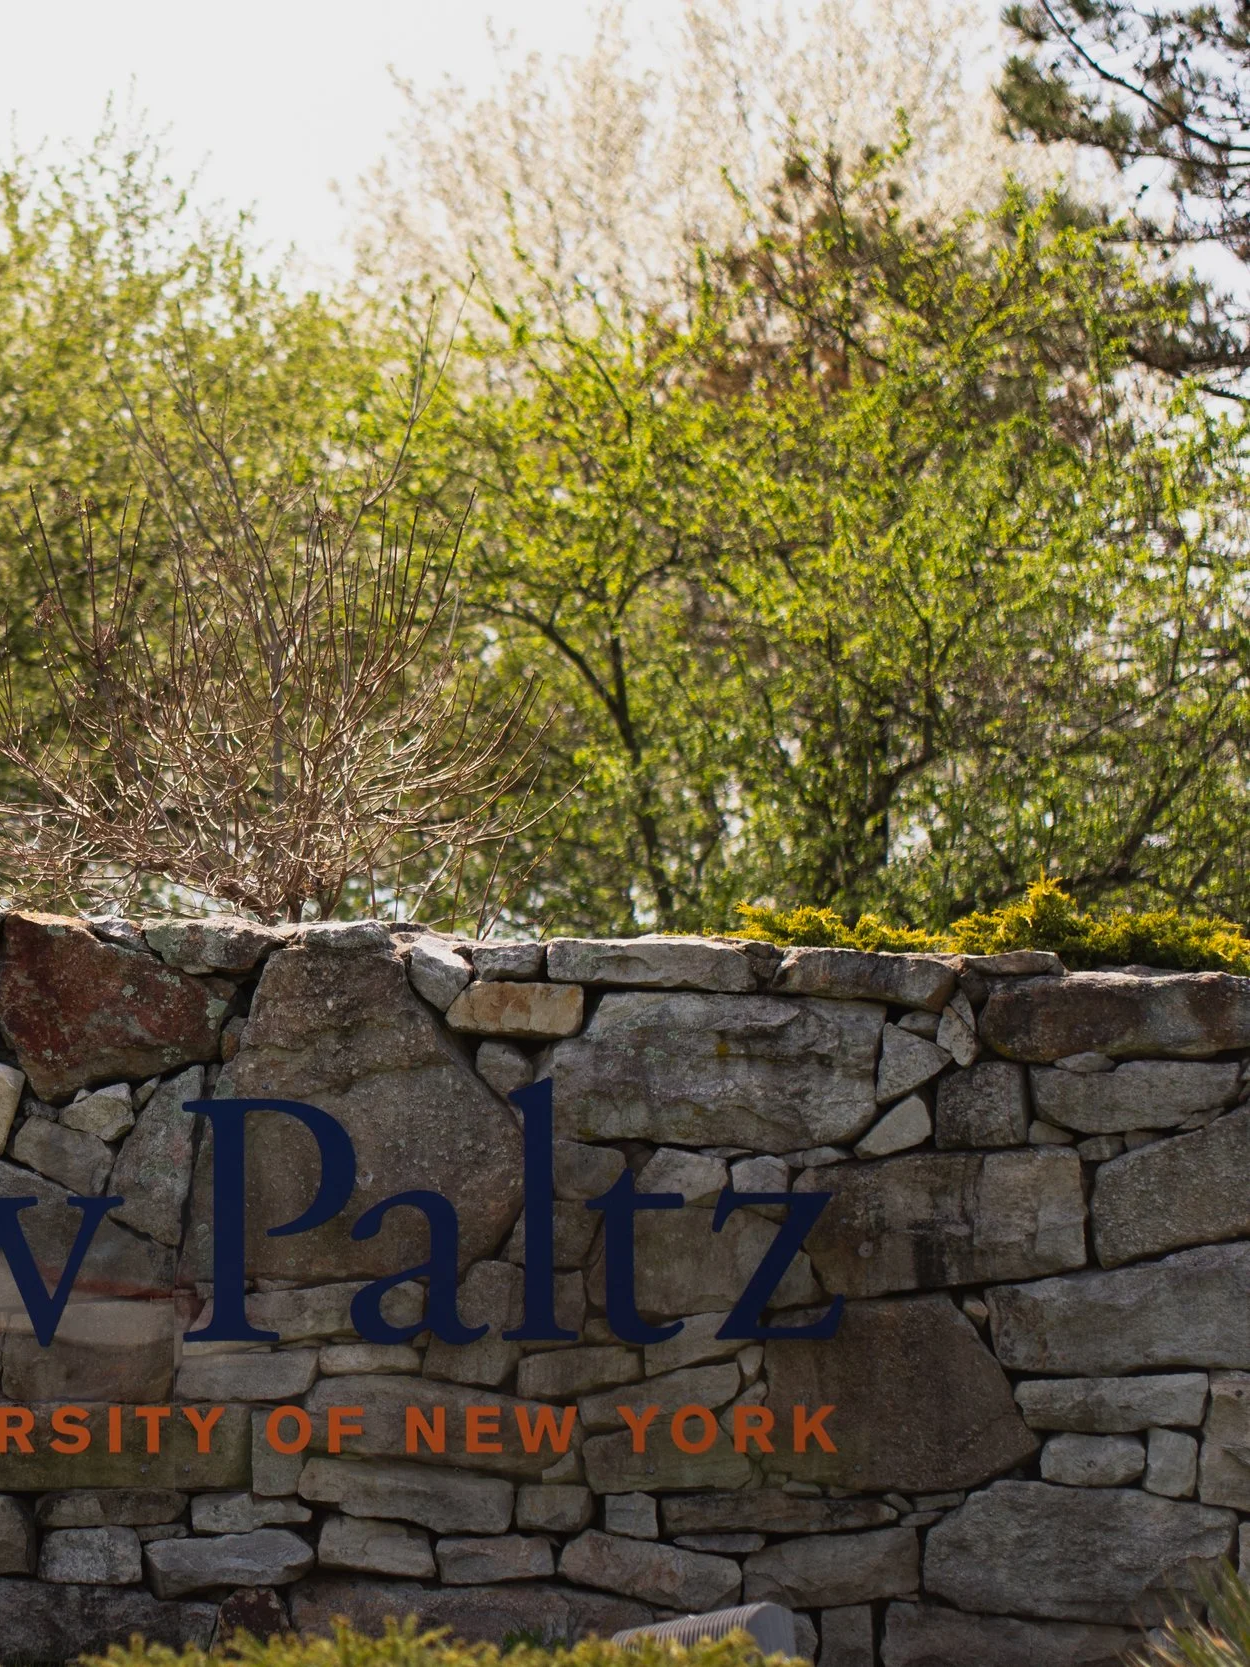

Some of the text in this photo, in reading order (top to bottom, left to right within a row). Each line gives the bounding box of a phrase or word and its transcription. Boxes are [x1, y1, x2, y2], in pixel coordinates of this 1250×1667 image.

[181, 1076, 845, 1347] Paltz
[264, 1404, 364, 1454] OF
[405, 1404, 577, 1454] NEW
[616, 1404, 838, 1454] YORK
